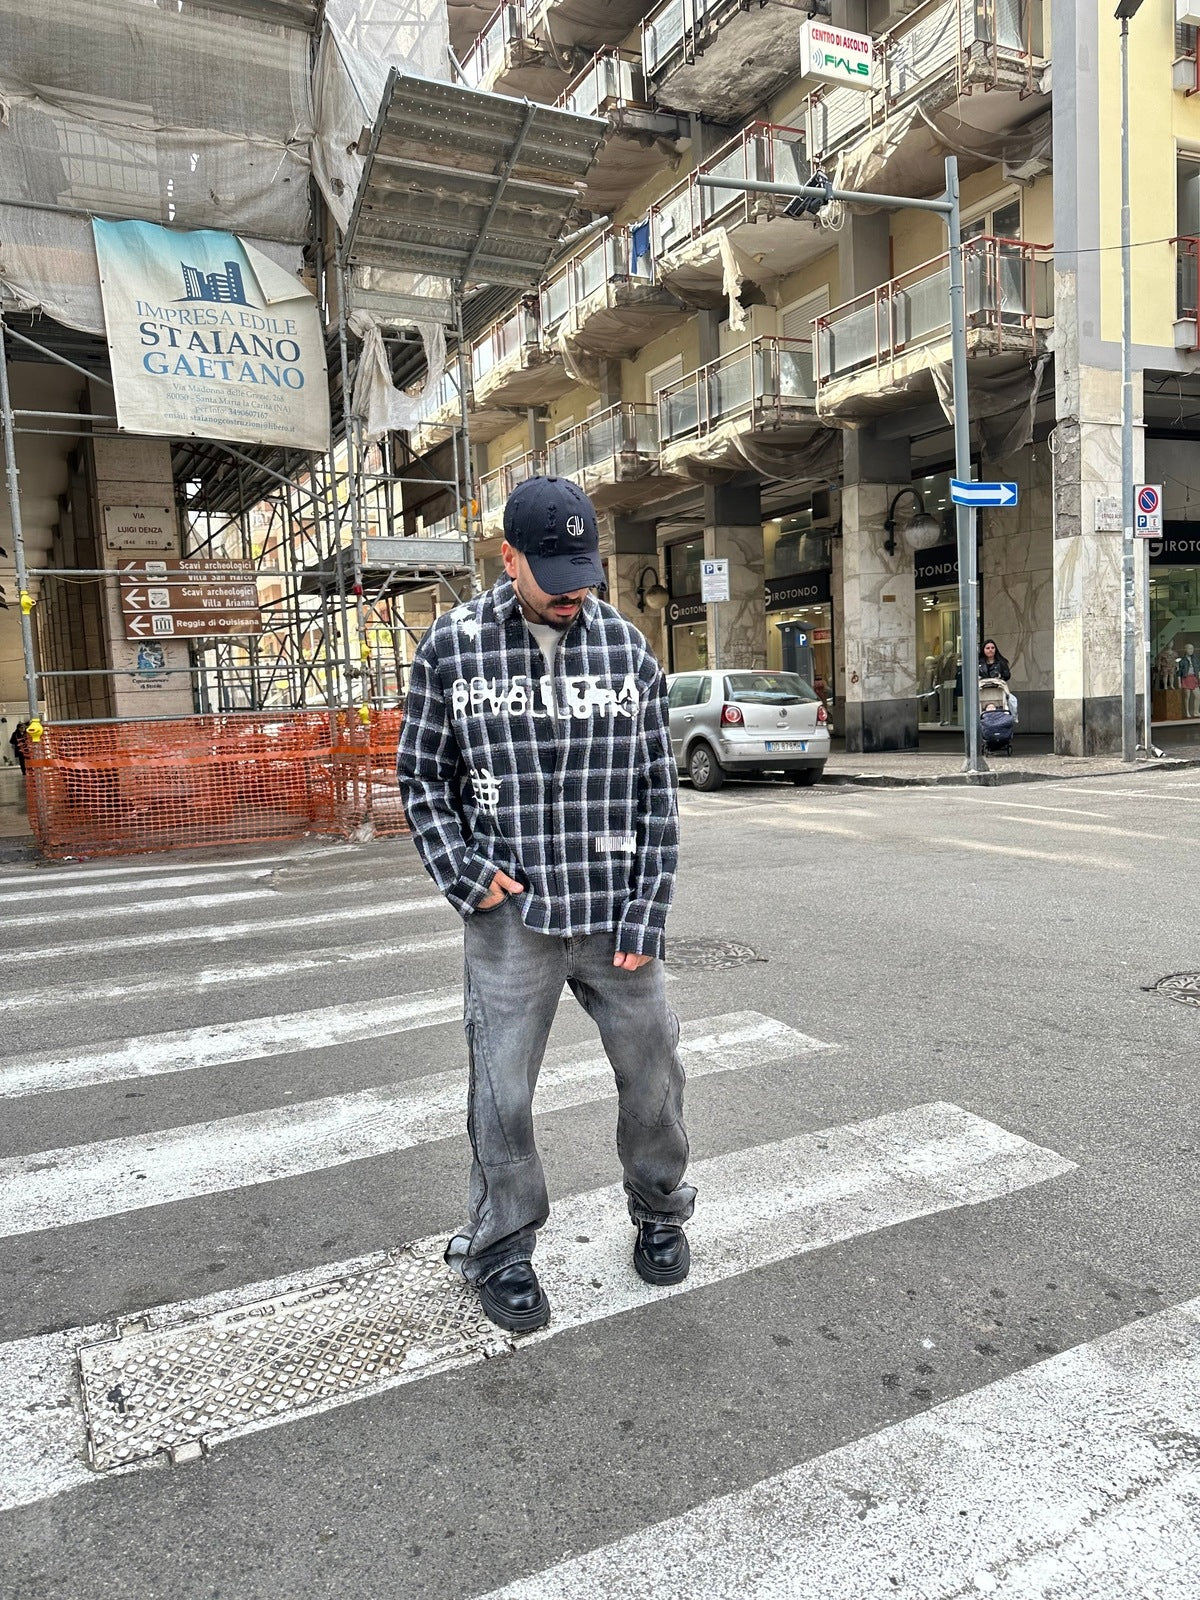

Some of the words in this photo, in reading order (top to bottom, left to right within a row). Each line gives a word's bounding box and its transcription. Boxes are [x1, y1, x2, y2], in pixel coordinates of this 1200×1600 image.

[812, 28, 835, 44] CENTRO
[836, 35, 842, 46] DI
[842, 37, 868, 54] ASCOLTO
[136, 300, 234, 325] IMPRESA
[238, 312, 298, 335] EDILE
[140, 322, 301, 362] STAIANO
[143, 352, 305, 390] GAETANO
[173, 383, 186, 392] Via
[188, 385, 224, 396] Madonna
[226, 388, 244, 397] delle
[194, 406, 208, 414] per
[196, 395, 218, 404] Santa
[219, 398, 241, 406] Maria
[274, 404, 291, 414] (NA)
[139, 526, 162, 534] DENZA
[179, 560, 201, 570] Scavi
[204, 560, 252, 571] archeologici
[182, 588, 203, 596] Scavi
[207, 588, 254, 598] archeologici
[764, 586, 818, 606] GIROTONDO
[202, 599, 222, 607] Villa
[226, 599, 255, 607] Arianna
[670, 603, 706, 620] GIROTOND
[176, 620, 206, 629] Reggia
[208, 618, 216, 626] di
[218, 618, 260, 627] Quisisana
